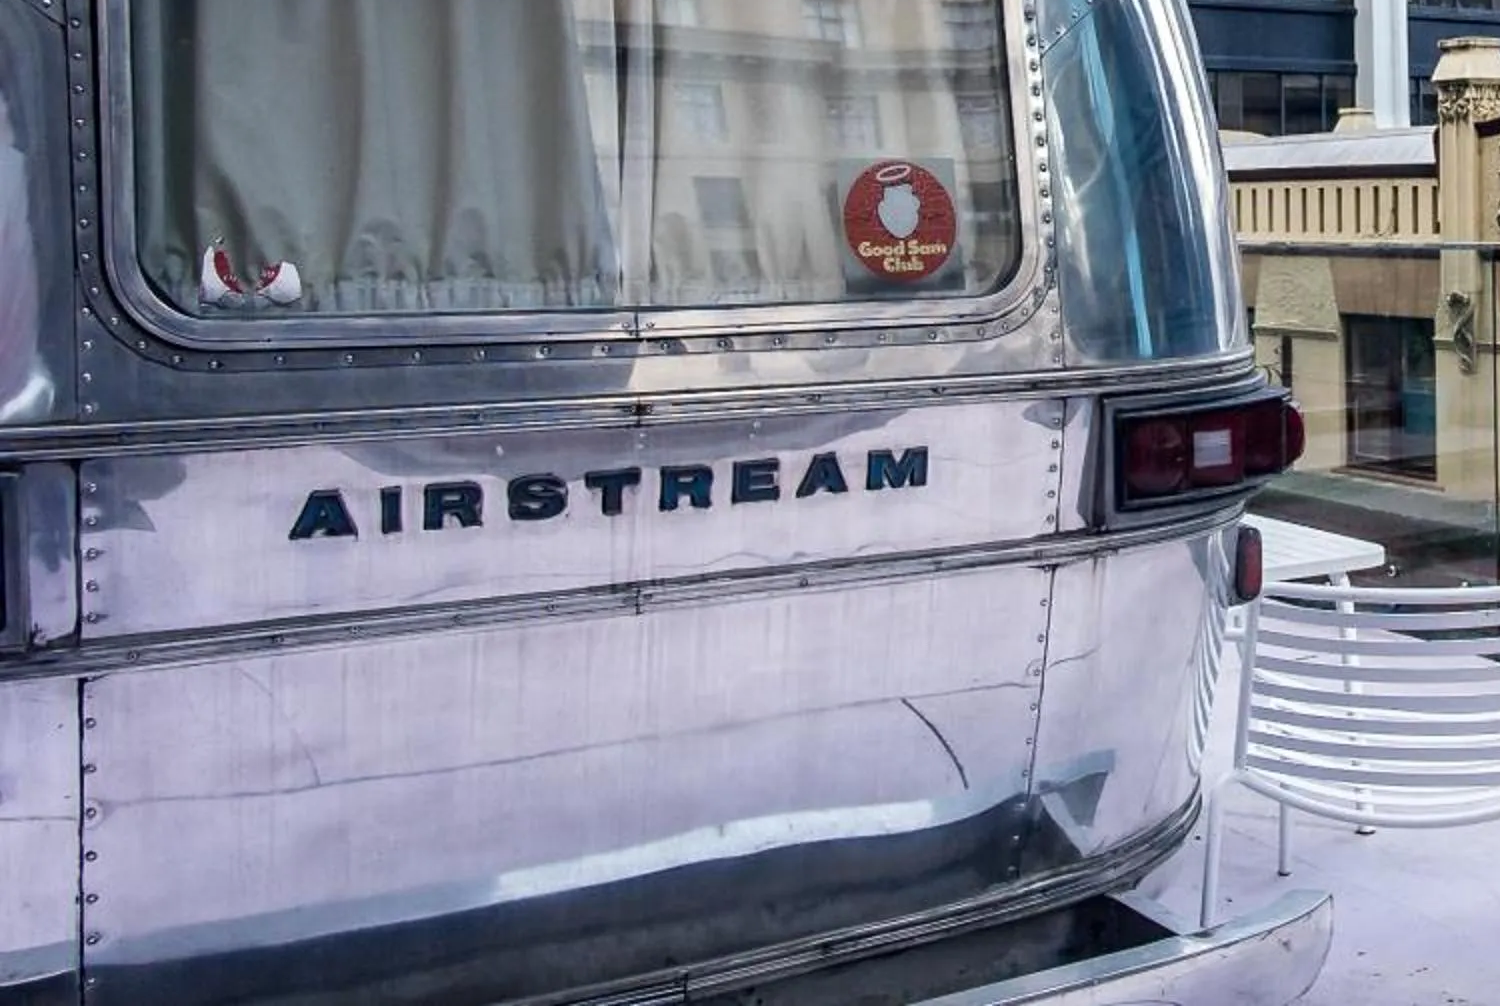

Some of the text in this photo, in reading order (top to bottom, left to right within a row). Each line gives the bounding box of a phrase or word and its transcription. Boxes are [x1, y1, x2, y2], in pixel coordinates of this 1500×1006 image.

[857, 239, 947, 257] Good Sam
[882, 256, 924, 273] Club
[288, 445, 929, 541] AIRSTREAM
